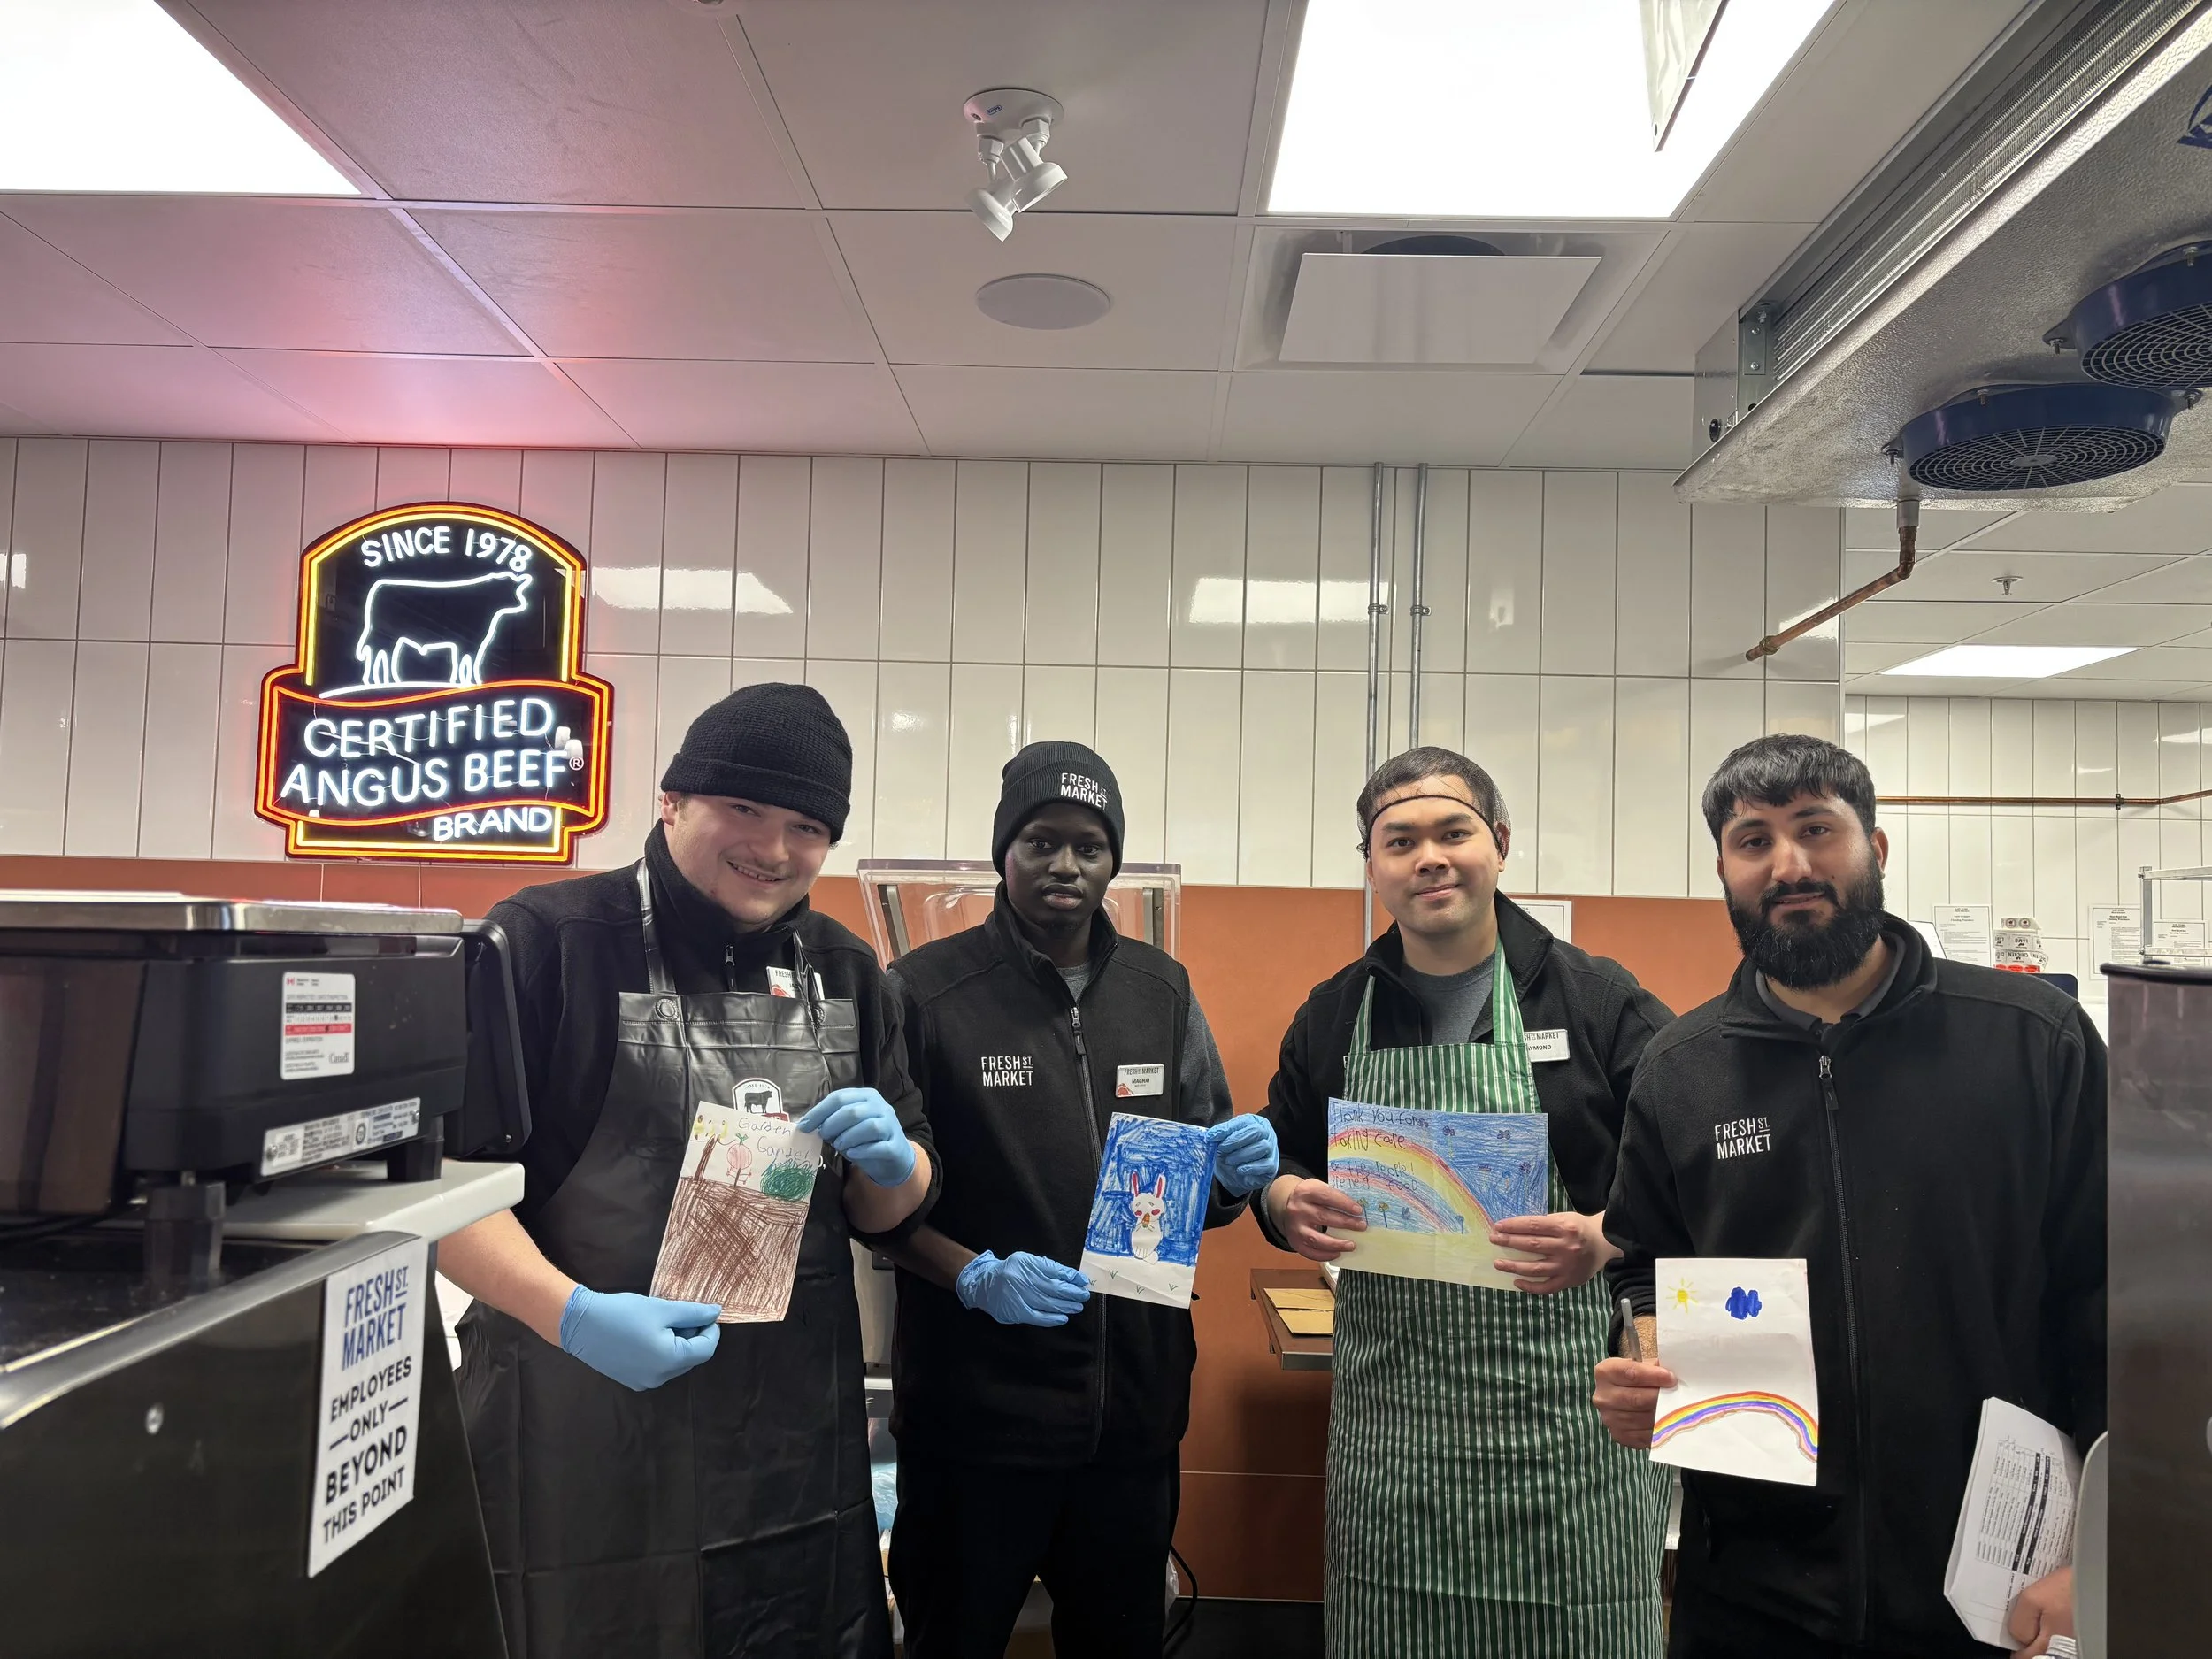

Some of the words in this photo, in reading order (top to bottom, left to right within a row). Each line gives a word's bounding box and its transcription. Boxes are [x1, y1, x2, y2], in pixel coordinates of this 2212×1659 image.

[360, 526, 450, 568] SINCE
[465, 528, 533, 572] 1978
[303, 697, 554, 758] CERTIFIED
[280, 757, 449, 808] ANGUS
[1060, 784, 1108, 810] MARKET
[1061, 772, 1099, 794] FRESH
[432, 806, 554, 841] BRAND
[981, 1056, 1021, 1071] FRESH
[982, 1071, 1034, 1087] MARKET
[1715, 1117, 1756, 1141] FRESH
[1717, 1134, 1772, 1160] MARKET
[344, 1271, 396, 1327] FRESH
[342, 1303, 406, 1372] MARKET
[330, 1356, 412, 1423] EMPLOYEES
[326, 1425, 408, 1506] BEYOND
[322, 1501, 357, 1544] THIS
[361, 1466, 405, 1518] POINT
